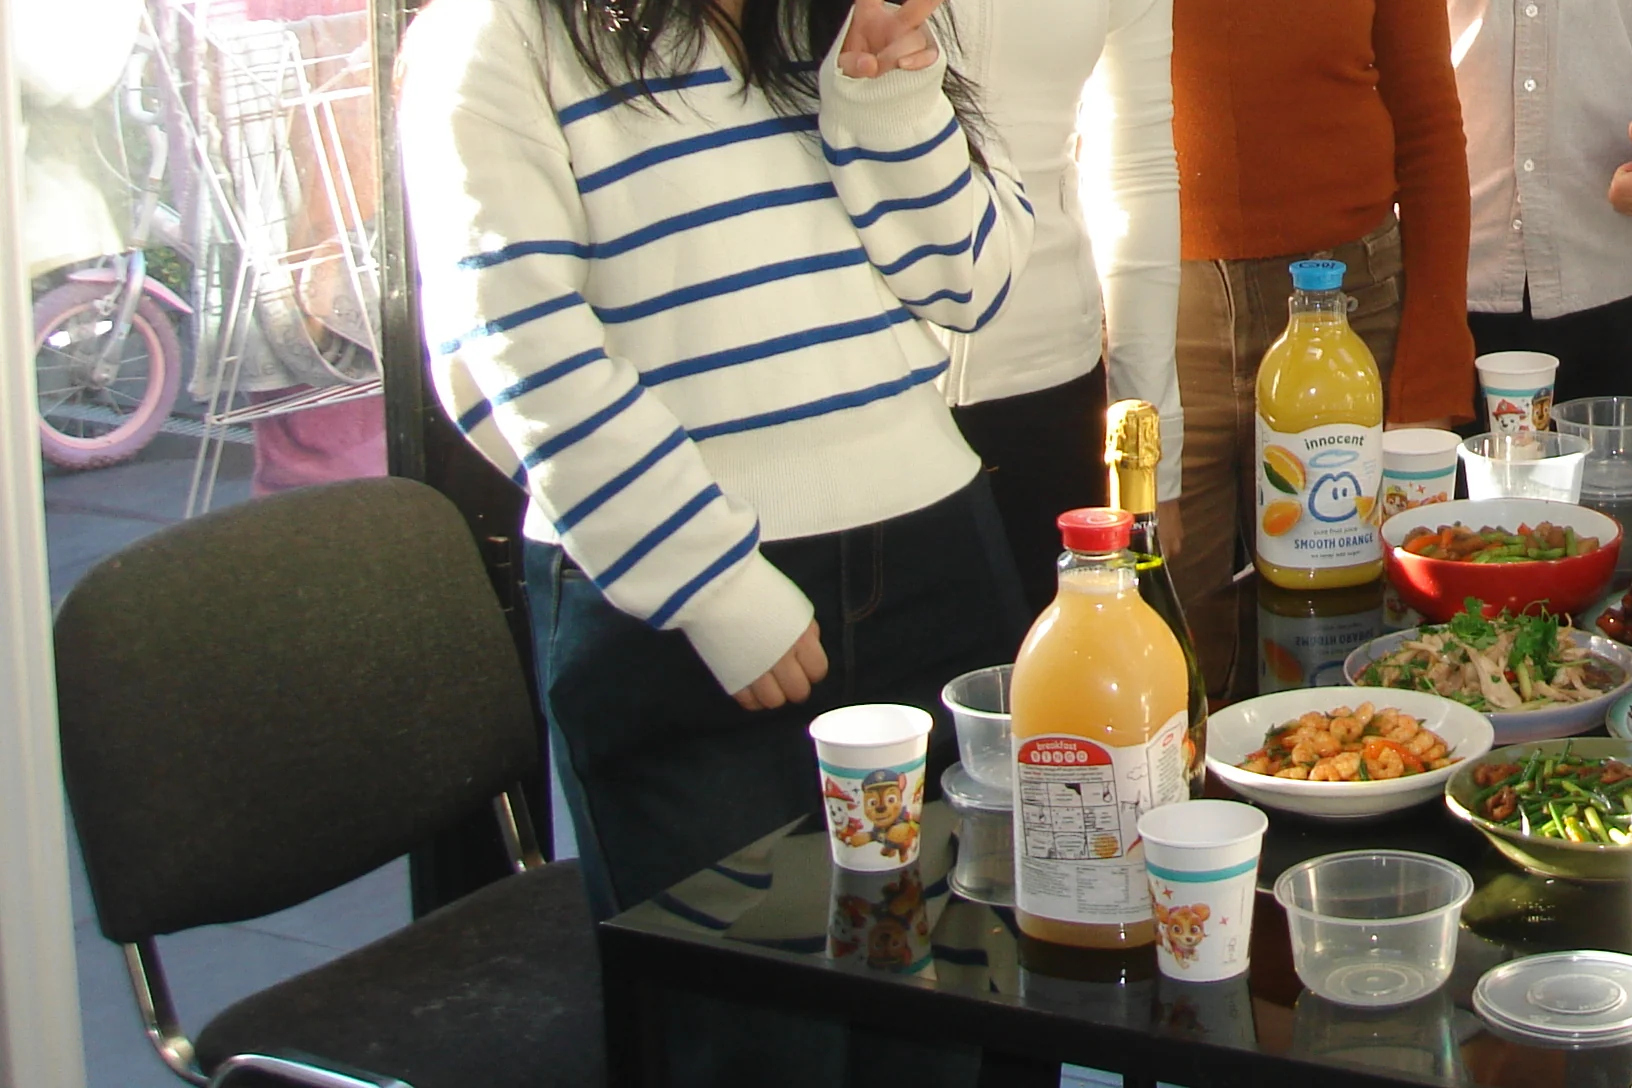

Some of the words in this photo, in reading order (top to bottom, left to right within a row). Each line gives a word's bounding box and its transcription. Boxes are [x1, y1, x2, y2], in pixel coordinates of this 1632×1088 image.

[1303, 435, 1365, 451] innocent
[1294, 538, 1336, 550] SMOOTH
[1338, 532, 1373, 549] ORANGE
